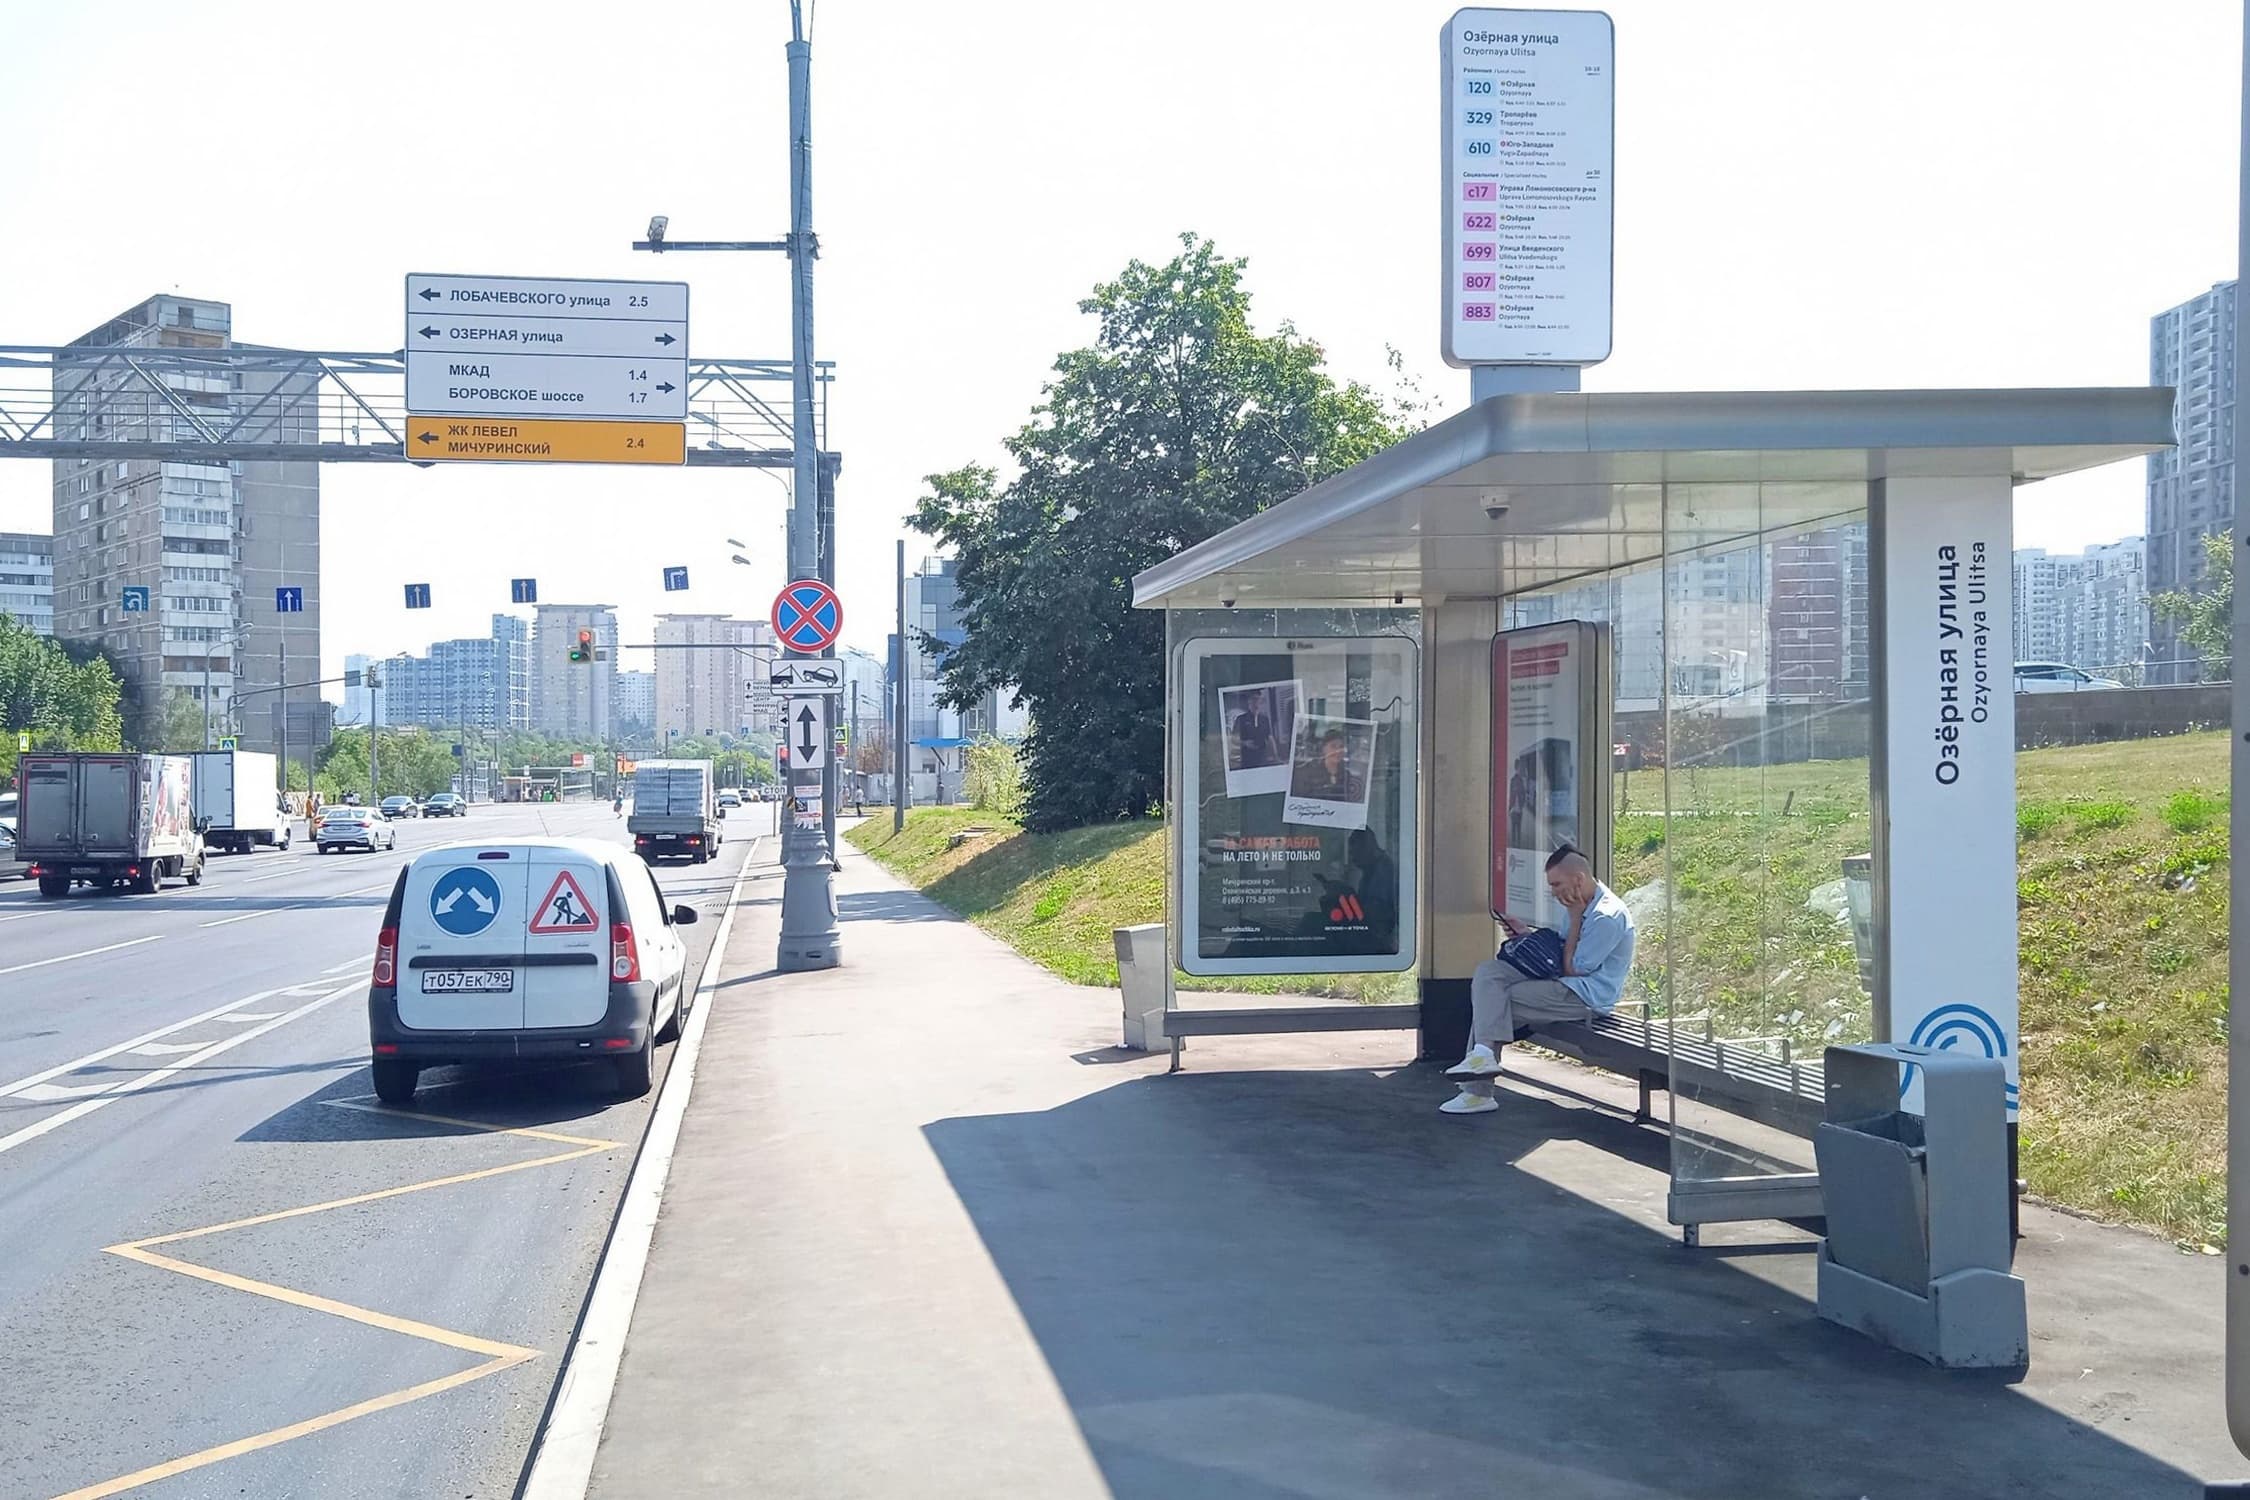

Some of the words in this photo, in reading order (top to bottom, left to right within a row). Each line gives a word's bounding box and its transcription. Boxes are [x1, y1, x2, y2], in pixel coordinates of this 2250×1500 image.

[1463, 30, 1518, 44] Озёрная
[1521, 34, 1559, 45] улица
[1463, 46, 1509, 56] Ozyornaya
[1511, 47, 1536, 56] Ulitsa
[1468, 82, 1491, 94] 120
[1467, 111, 1493, 124] 329
[1468, 142, 1491, 154] 610
[1468, 186, 1489, 198] с17
[1466, 216, 1492, 228] 622
[1466, 246, 1492, 258] 699
[1466, 276, 1491, 288] 807
[450, 290, 566, 305] ЛОБАЧЕВСКОГО
[569, 296, 610, 308] улица
[628, 295, 649, 307] 2.5
[1466, 306, 1491, 318] 883
[450, 328, 517, 340] ОЗЕРНАЯ
[521, 333, 563, 343] улица
[449, 365, 490, 378] МКАД
[628, 369, 647, 380] 1.4
[449, 388, 537, 400] БОРОВСКОЕ
[542, 392, 584, 402] шоссе
[628, 392, 647, 403] 1.7
[448, 425, 468, 436] ЖК
[471, 426, 517, 437] ЛЕВЕЛ
[448, 442, 550, 454] МИЧУРИНСКИЙ
[626, 438, 645, 448] 2.4
[1968, 542, 1986, 603] Ulitsa
[1938, 546, 1963, 639] улица
[1971, 611, 1991, 723] Ozyornaya
[1935, 649, 1964, 784] Озёрная
[1223, 851, 1236, 862] НА
[1237, 851, 1260, 862] ЛЕТО
[1261, 851, 1269, 861] И
[1271, 851, 1284, 861] НЕ
[1285, 850, 1321, 861] ТОЛЬКО
[428, 972, 483, 987] Т057ЕК
[486, 971, 510, 983] 790
